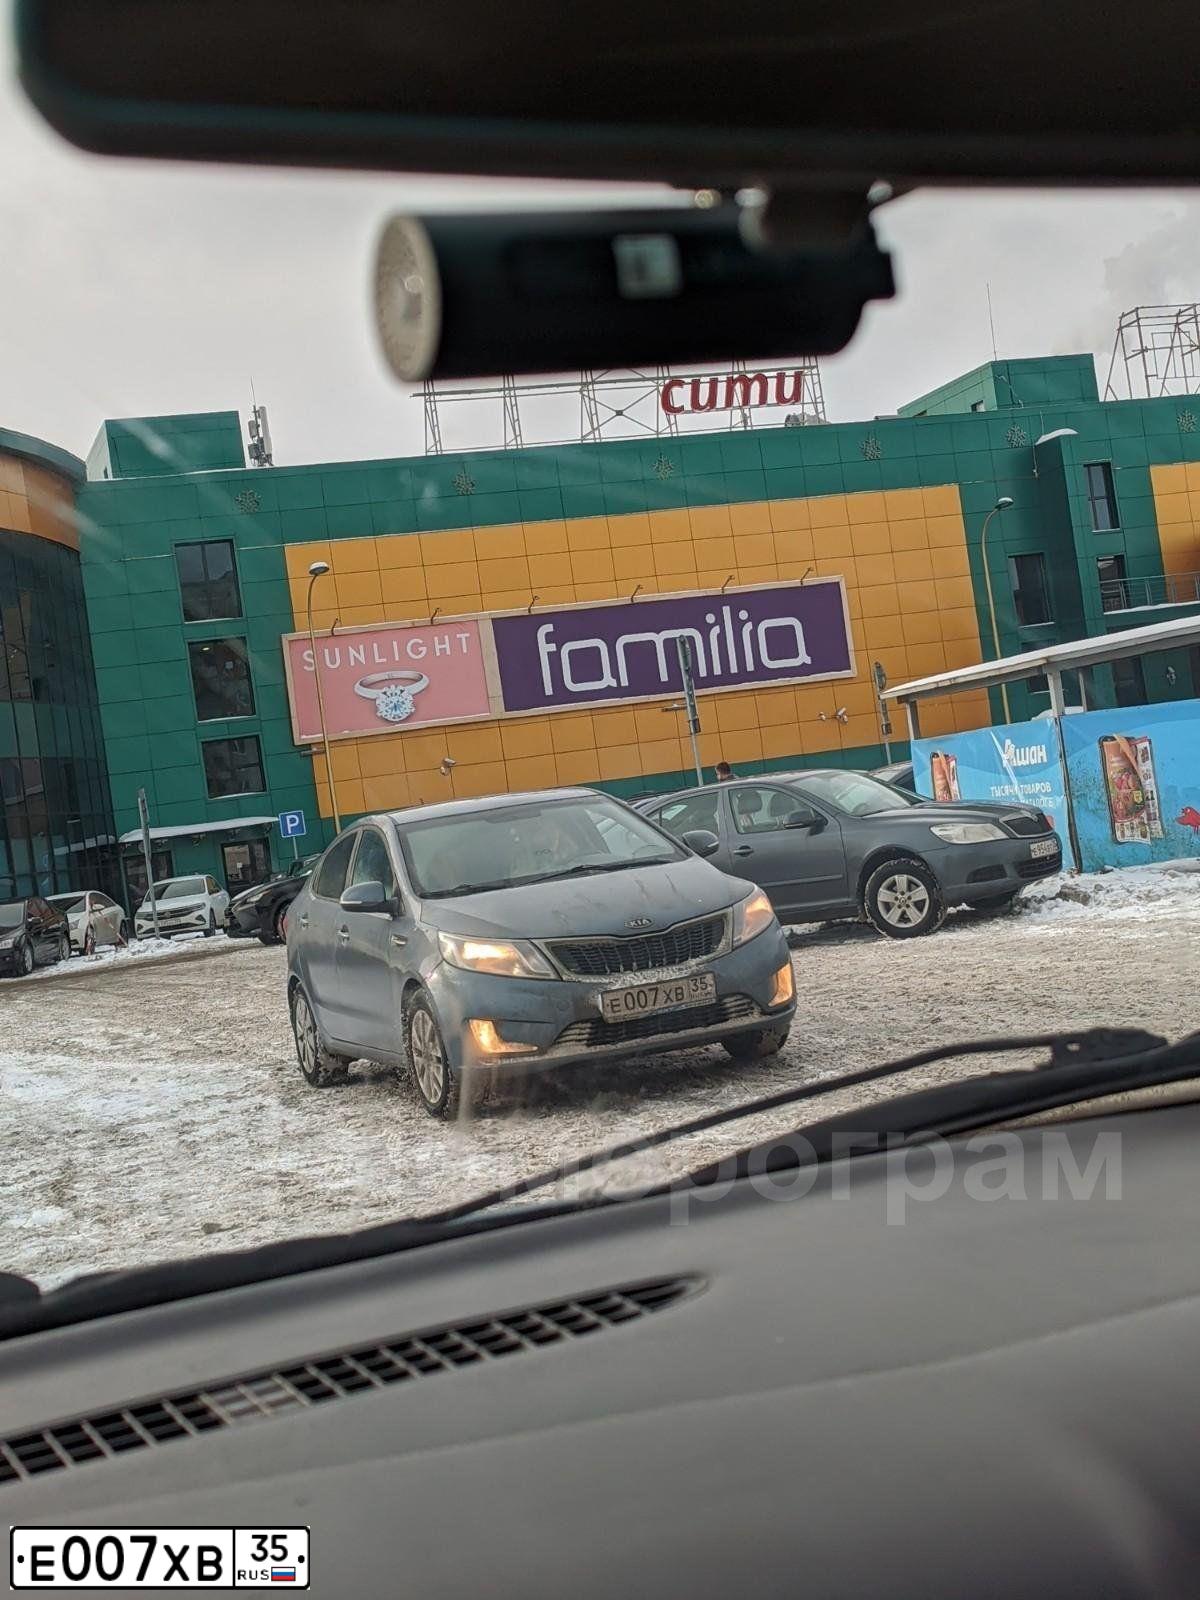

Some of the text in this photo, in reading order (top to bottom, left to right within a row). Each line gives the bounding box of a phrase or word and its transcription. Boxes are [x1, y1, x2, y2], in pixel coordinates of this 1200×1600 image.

[661, 371, 804, 415] сити
[302, 632, 471, 672] SUNLIGHT
[537, 605, 812, 697] familia
[286, 814, 299, 833] P
[630, 918, 649, 927] KIA
[609, 976, 708, 1013] Е007ХВ 35
